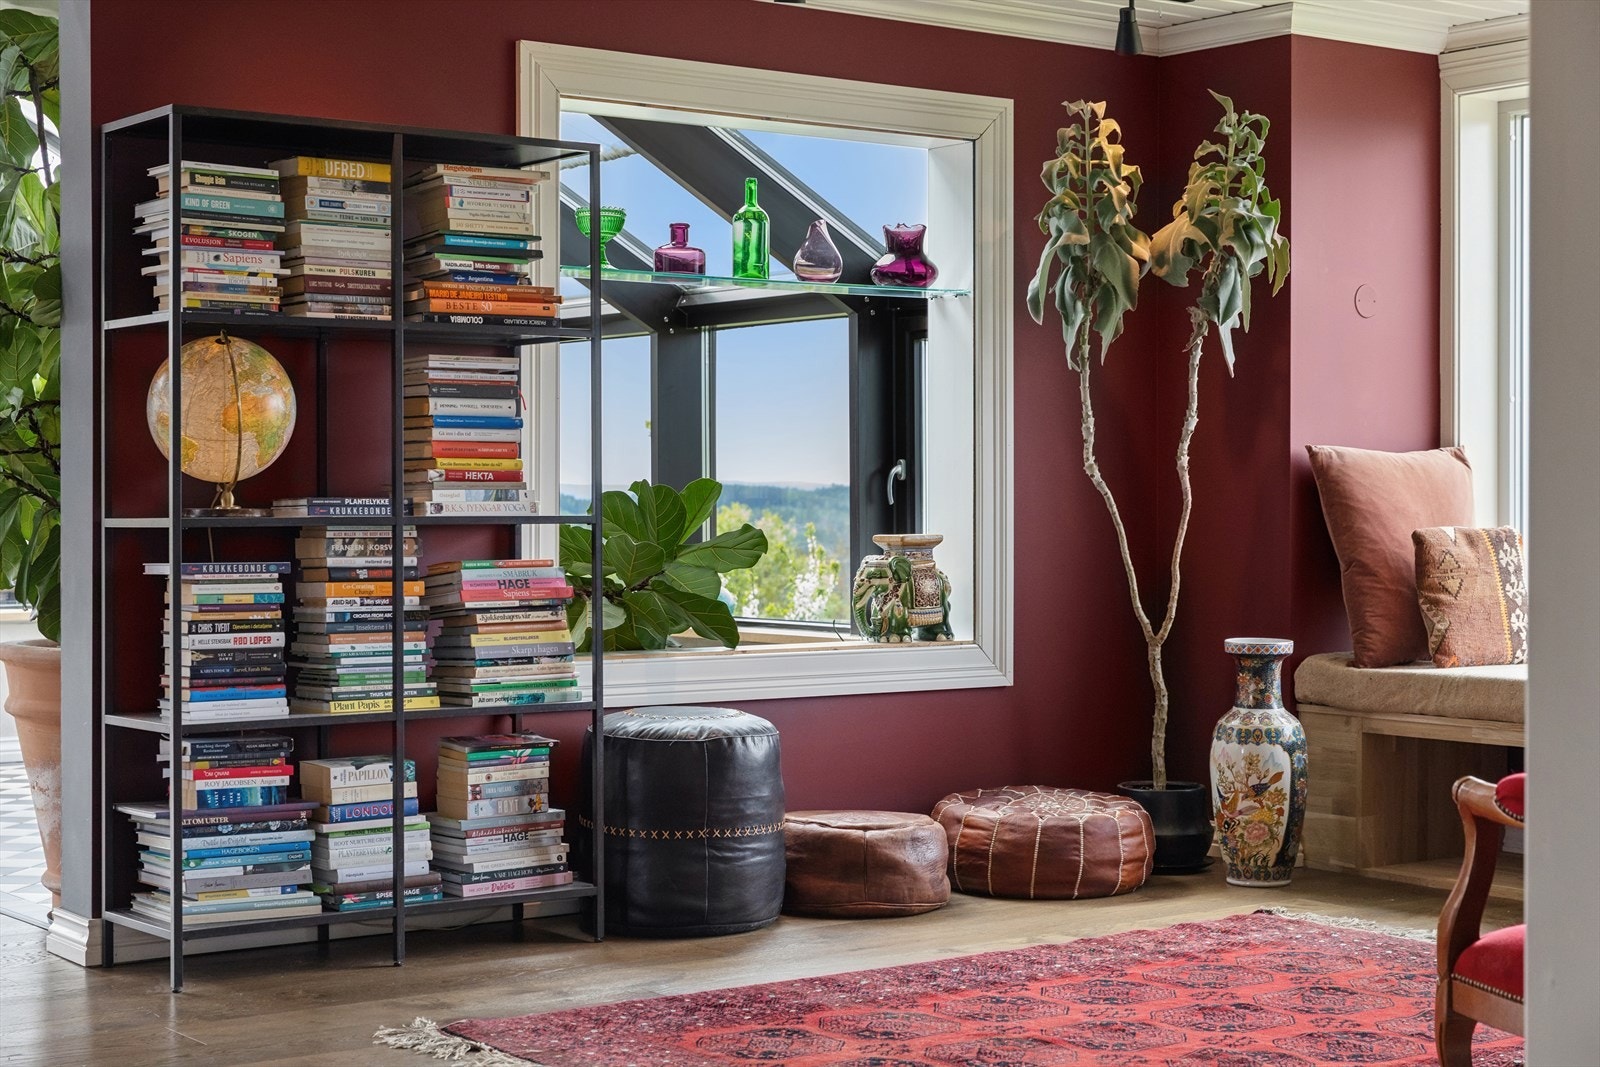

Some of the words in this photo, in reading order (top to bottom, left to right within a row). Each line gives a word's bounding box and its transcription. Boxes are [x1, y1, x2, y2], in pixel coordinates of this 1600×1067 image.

[324, 160, 365, 179] UFRED
[443, 165, 482, 173] Hageboken
[468, 179, 498, 188] STAUDER
[184, 197, 200, 207] KIND
[201, 198, 209, 208] OF
[210, 199, 231, 209] GREEN
[228, 230, 258, 238] SKOGEN
[185, 237, 221, 245] EVOLUSJON
[223, 251, 263, 265] Sapiens
[339, 268, 376, 277] PULSKUREN
[466, 284, 502, 292] CARTAGENA
[429, 289, 449, 298] MARIO
[450, 291, 458, 299] DE
[458, 291, 483, 300] JANEIRO
[484, 293, 508, 301] TESTINO
[445, 302, 477, 310] BESTE
[480, 301, 492, 312] 50
[450, 315, 483, 324] COLOMBIA
[465, 472, 494, 480] HEKTA
[329, 507, 392, 515] KRUKKEBONDE
[444, 504, 464, 512] B.K.S.
[466, 504, 501, 512] IYENGAR
[503, 504, 526, 512] YOGA
[202, 564, 267, 573] KRUKKEBONDE
[502, 569, 537, 577] SMÅBRUK
[497, 579, 531, 589] HAGE
[503, 590, 530, 599] Sapiens
[197, 623, 213, 633] CHRIS
[214, 622, 230, 632] TVEDT
[355, 623, 384, 631] Insektene
[233, 636, 247, 645] RØD
[249, 636, 272, 644] LØPER
[511, 646, 533, 655] Skarp
[537, 644, 558, 654] hagen
[333, 701, 355, 710] Plant
[357, 701, 380, 710] Papis
[348, 769, 389, 781] PAPILLON
[221, 779, 257, 788] JACOBSEN
[345, 804, 393, 818] LONDO
[204, 816, 229, 824] URTER
[350, 838, 375, 846] NURTURE
[502, 832, 529, 843] HAGE
[221, 846, 260, 855] HAGEBOKEN
